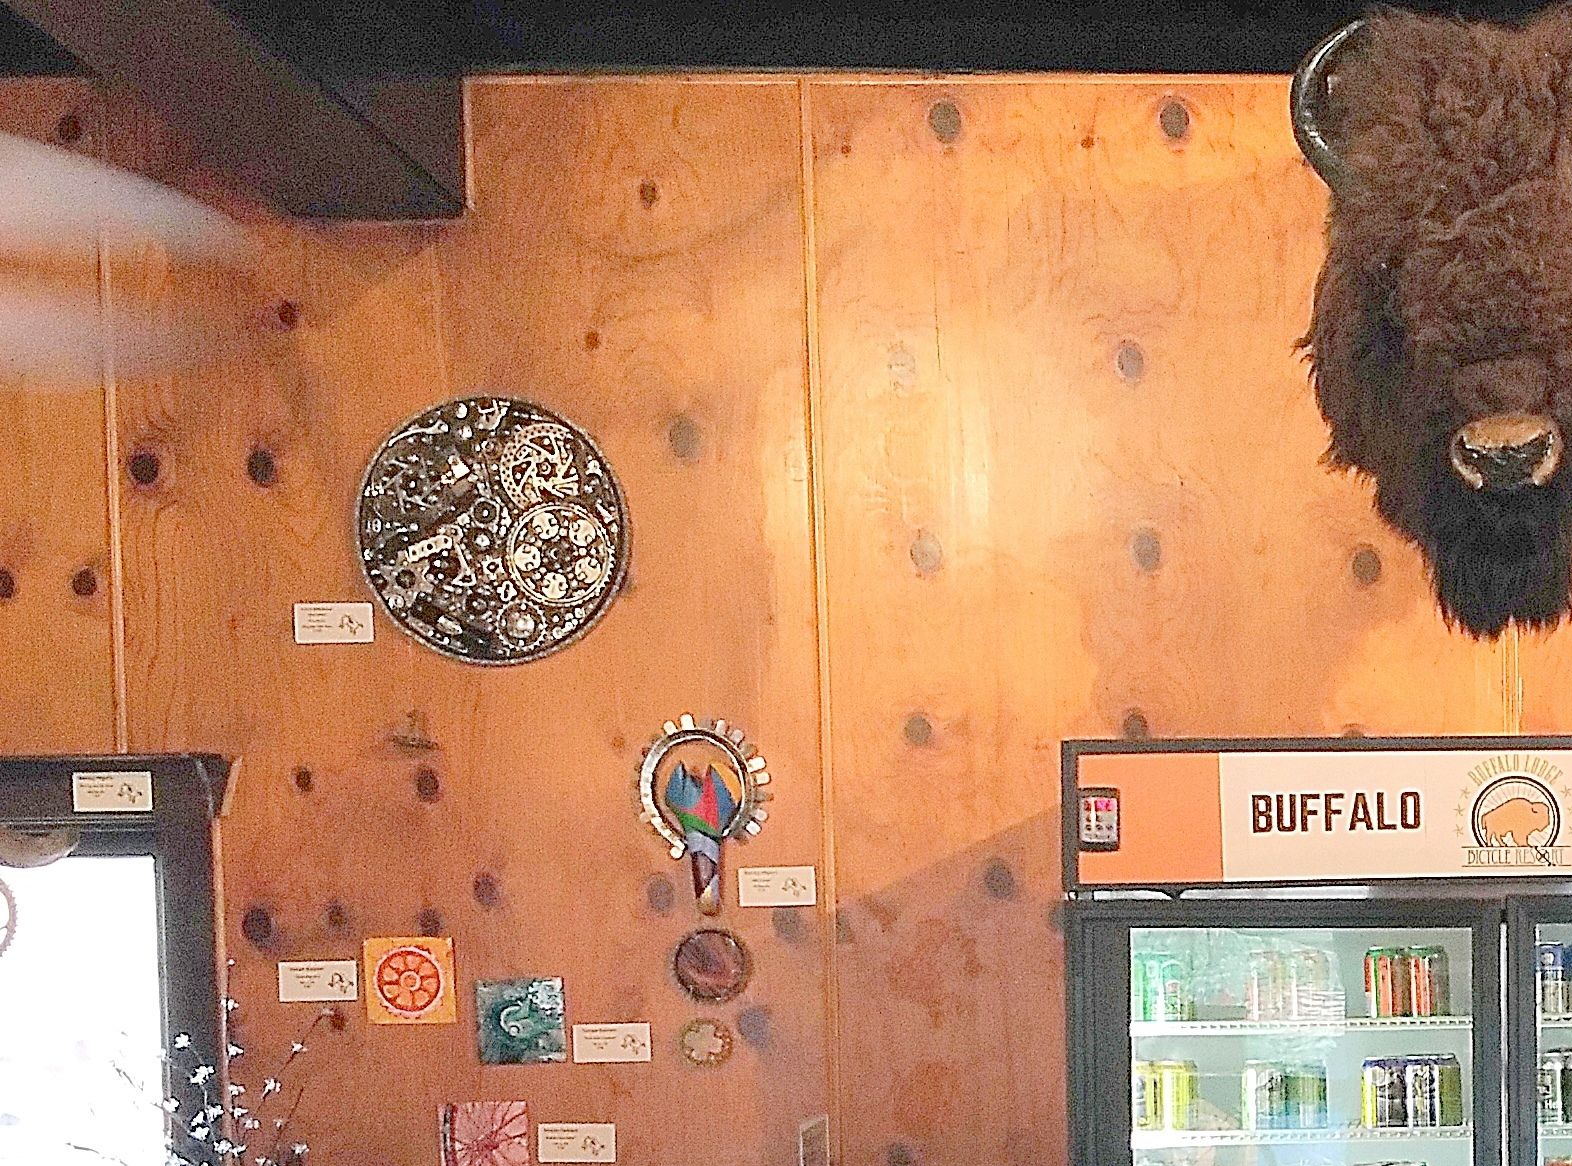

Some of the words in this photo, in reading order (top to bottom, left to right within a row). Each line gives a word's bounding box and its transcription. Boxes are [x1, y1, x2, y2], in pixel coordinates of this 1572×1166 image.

[1468, 754, 1519, 786] BUFFALO
[1525, 754, 1563, 784] LODGE
[1251, 790, 1421, 834] BUFFALO
[1467, 849, 1511, 864] BICYCLE
